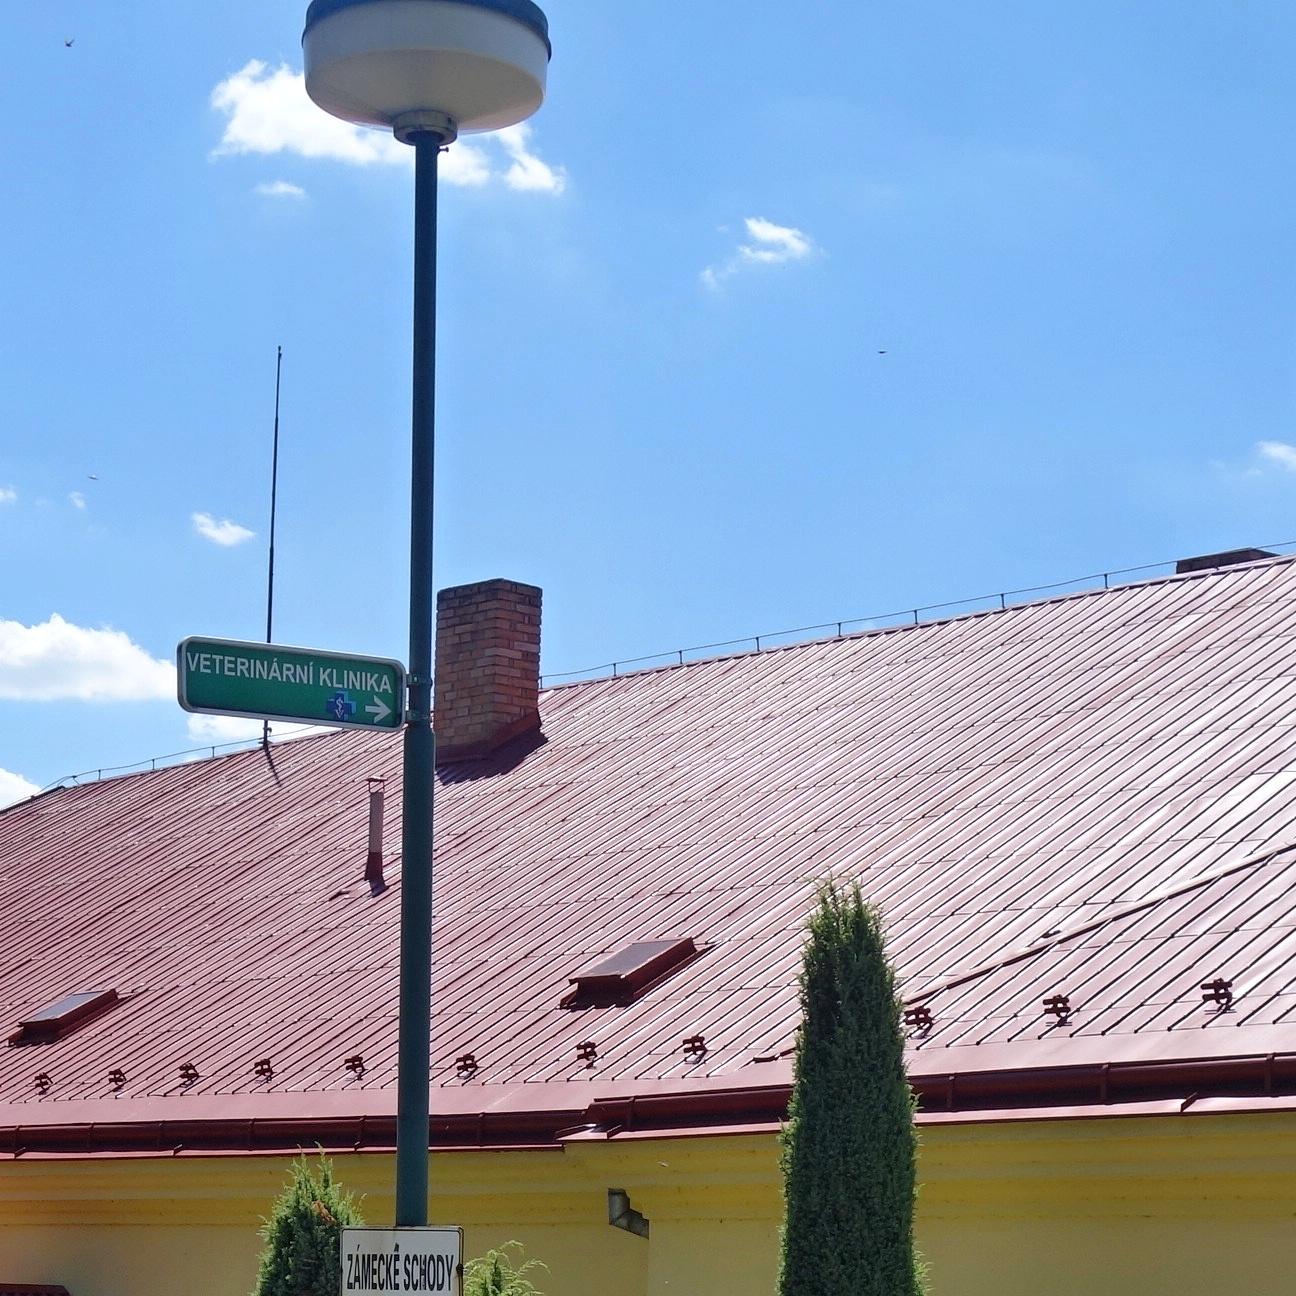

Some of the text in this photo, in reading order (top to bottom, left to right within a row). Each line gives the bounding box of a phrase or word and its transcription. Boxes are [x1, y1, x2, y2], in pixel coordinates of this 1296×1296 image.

[187, 652, 392, 693] VETERINÁRNÍ KLINIKA
[347, 1243, 454, 1291] ZÁMECKÉ SCHODY
